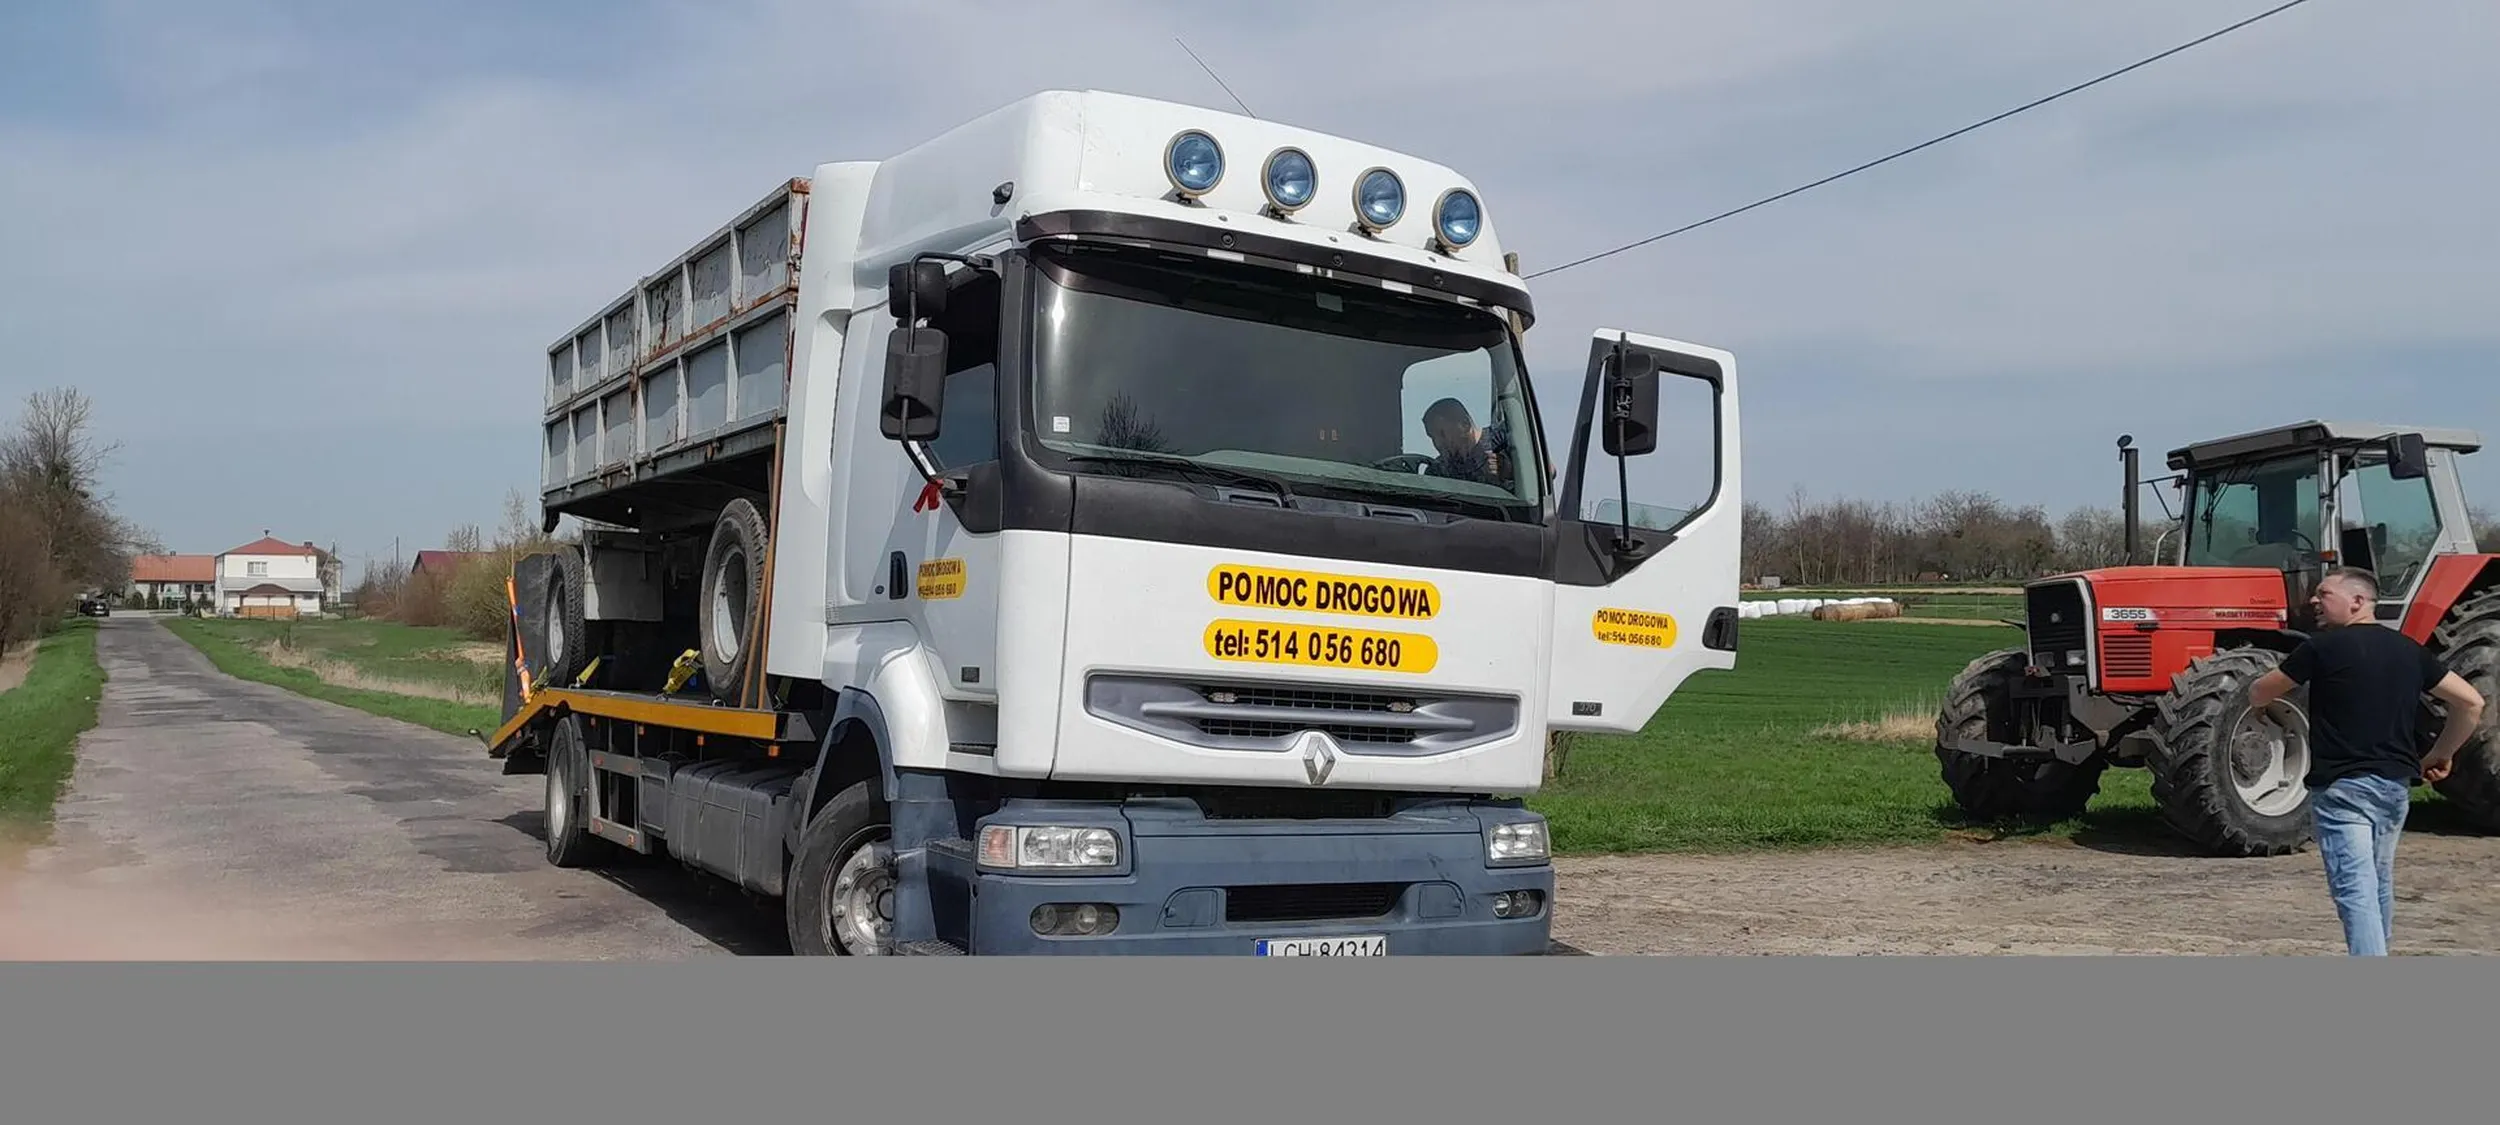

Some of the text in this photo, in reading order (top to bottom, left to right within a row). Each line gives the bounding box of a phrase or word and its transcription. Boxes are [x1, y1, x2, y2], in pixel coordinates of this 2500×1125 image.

[1218, 572, 1432, 617] POMOC DROGOWA
[1597, 610, 1669, 629] POMOC DROGOWA
[2111, 609, 2147, 619] 3655
[1309, 632, 1353, 663] 056
[1361, 636, 1401, 667] 680
